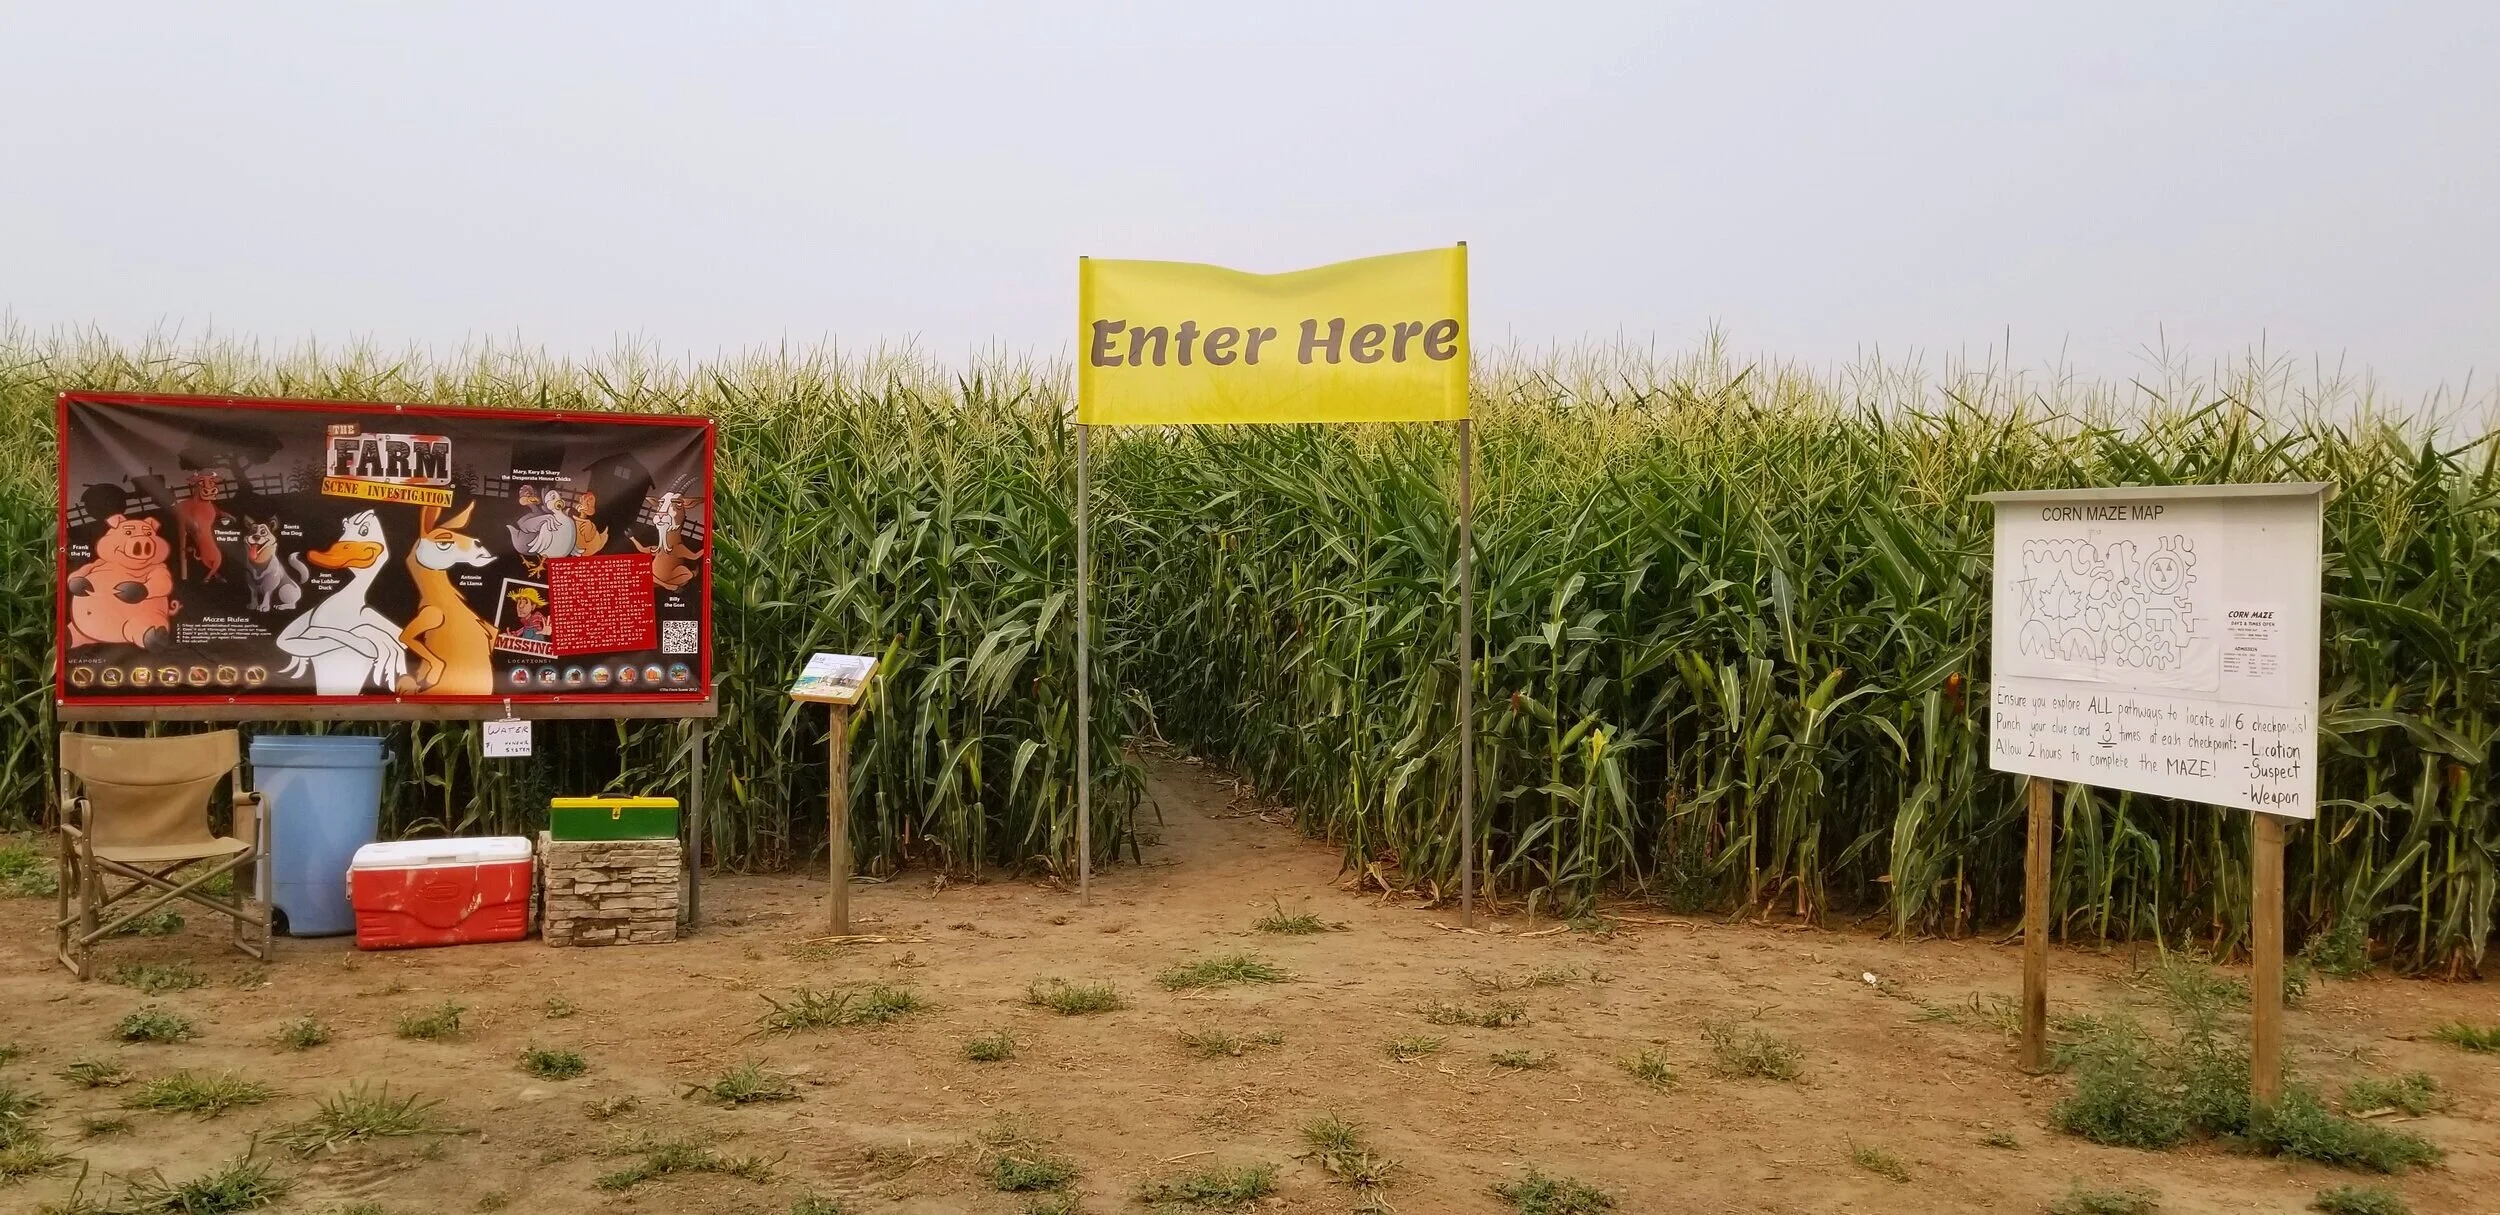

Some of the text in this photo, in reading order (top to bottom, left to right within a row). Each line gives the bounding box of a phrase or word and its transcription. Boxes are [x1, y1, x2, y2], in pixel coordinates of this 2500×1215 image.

[1091, 316, 1460, 367] Enter Here
[333, 424, 354, 434] THE
[334, 440, 449, 478] FARM
[324, 480, 452, 505] SCENE INVESTIGATION
[2042, 505, 2164, 521] CORN MAZE MAP
[496, 636, 553, 656] MISSING
[1998, 686, 2026, 707] Ensure
[2032, 697, 2046, 716] you
[2053, 694, 2081, 712] explore
[2088, 696, 2112, 714] ALL
[2118, 700, 2163, 727] pathways
[2168, 704, 2177, 720] to
[2186, 706, 2214, 728] locate
[2220, 712, 2231, 728] all
[2235, 713, 2244, 730] 6
[488, 726, 528, 735] WATER
[1996, 712, 2237, 754] Punch your clue card 3 times at each checkpoint:
[1996, 738, 2216, 778] Allow 2 hours to complete the MAZE!
[2242, 737, 2300, 760] -Lcation
